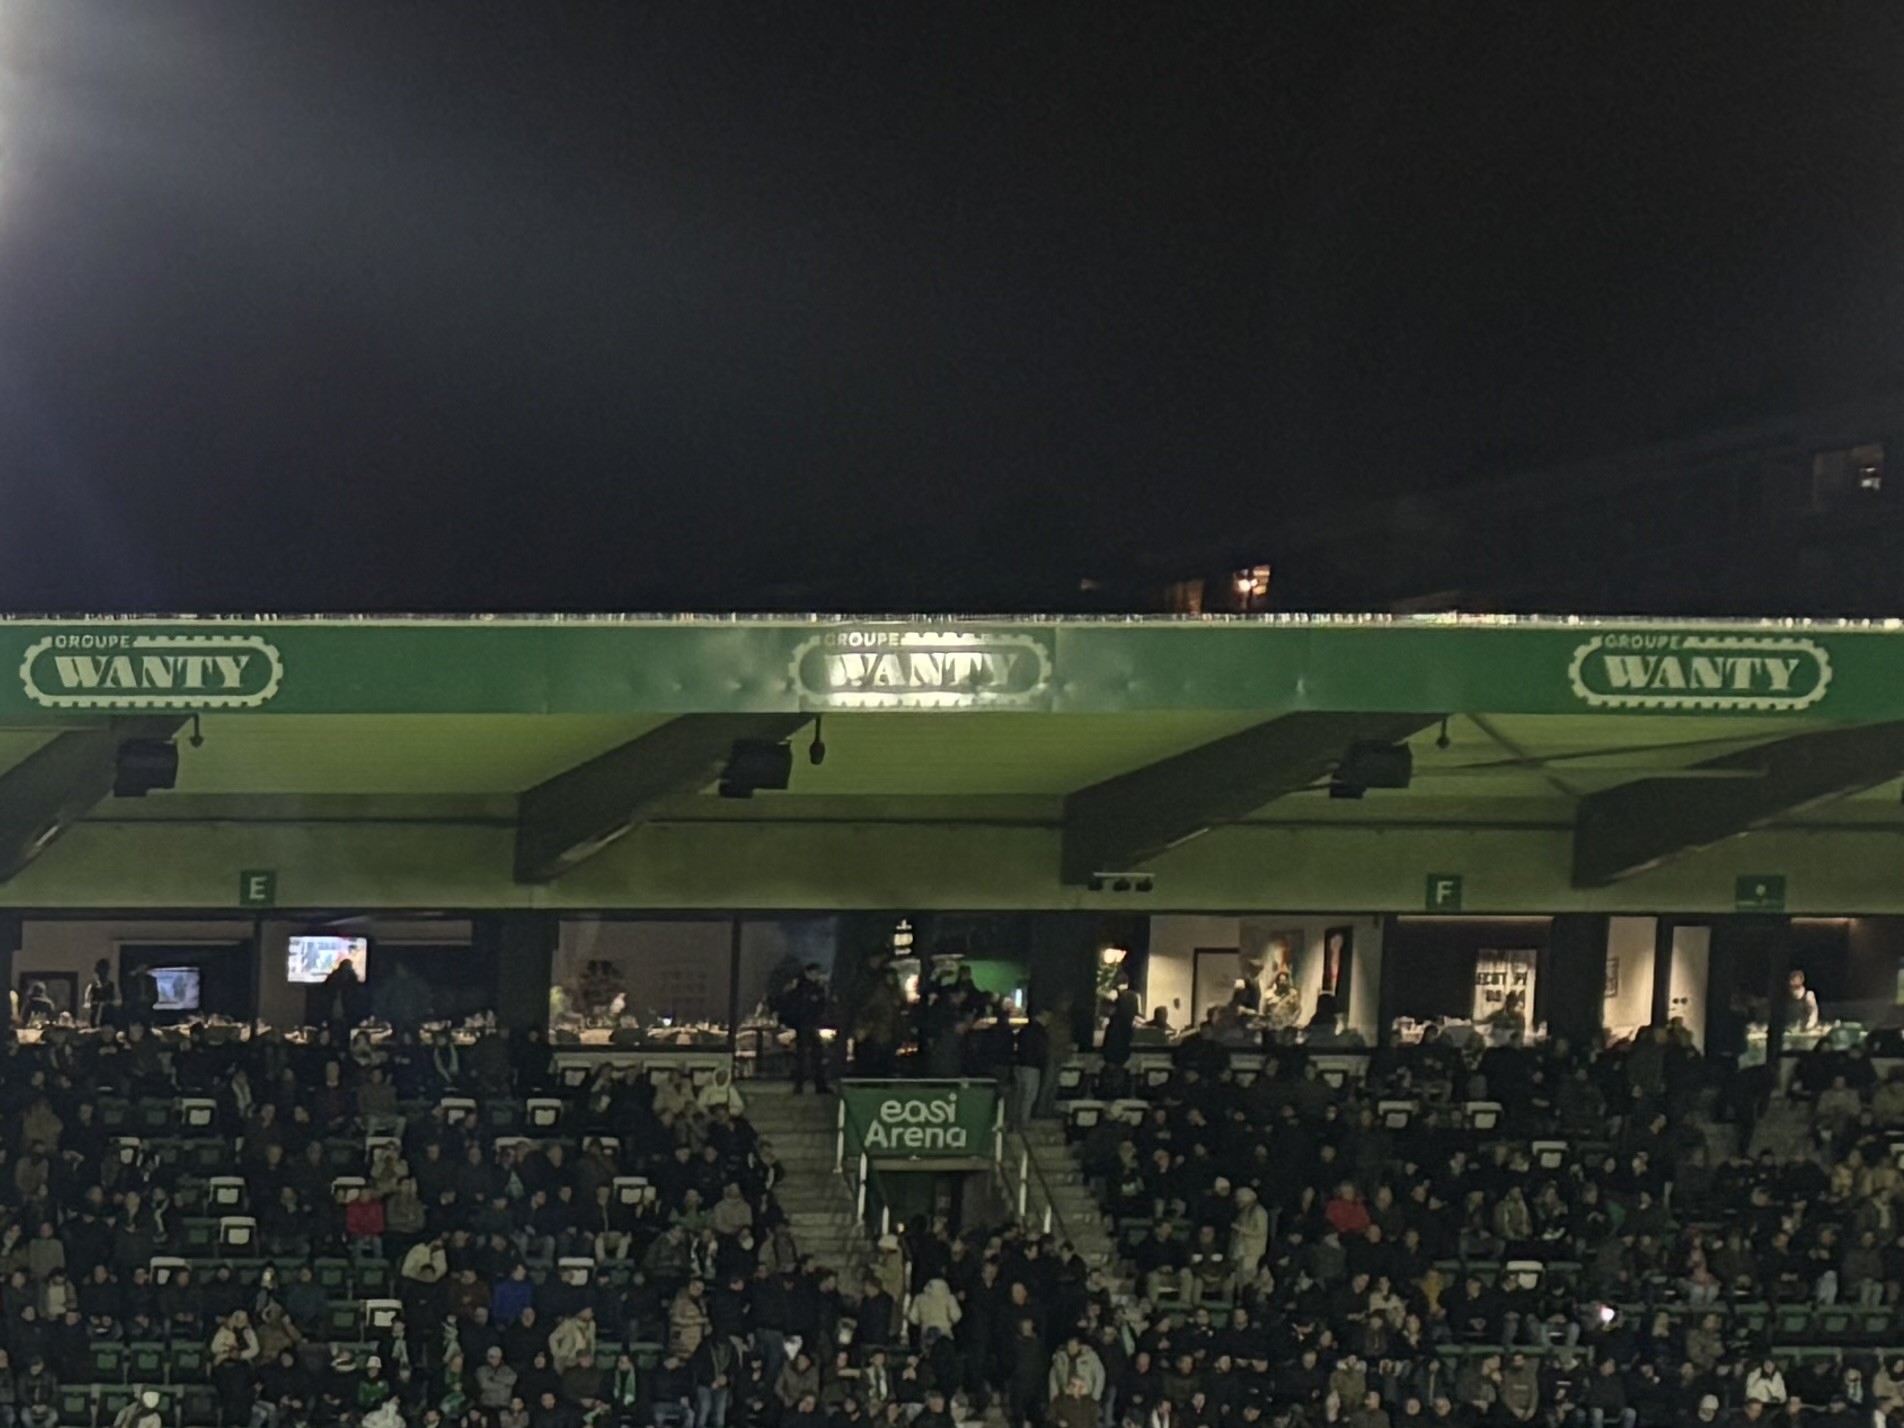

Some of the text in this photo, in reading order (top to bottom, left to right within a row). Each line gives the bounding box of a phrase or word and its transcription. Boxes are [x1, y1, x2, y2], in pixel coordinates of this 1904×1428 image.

[55, 635, 131, 648] GROUPE
[823, 632, 901, 646] GROUPE
[1604, 635, 1681, 649] GROUPE
[54, 656, 252, 688] WANTY
[824, 652, 1019, 687] WANTY
[1603, 655, 1800, 691] WANTY
[249, 876, 268, 899] E
[1436, 880, 1454, 904] F
[879, 1092, 958, 1123] easi
[864, 1119, 967, 1148] Arena
